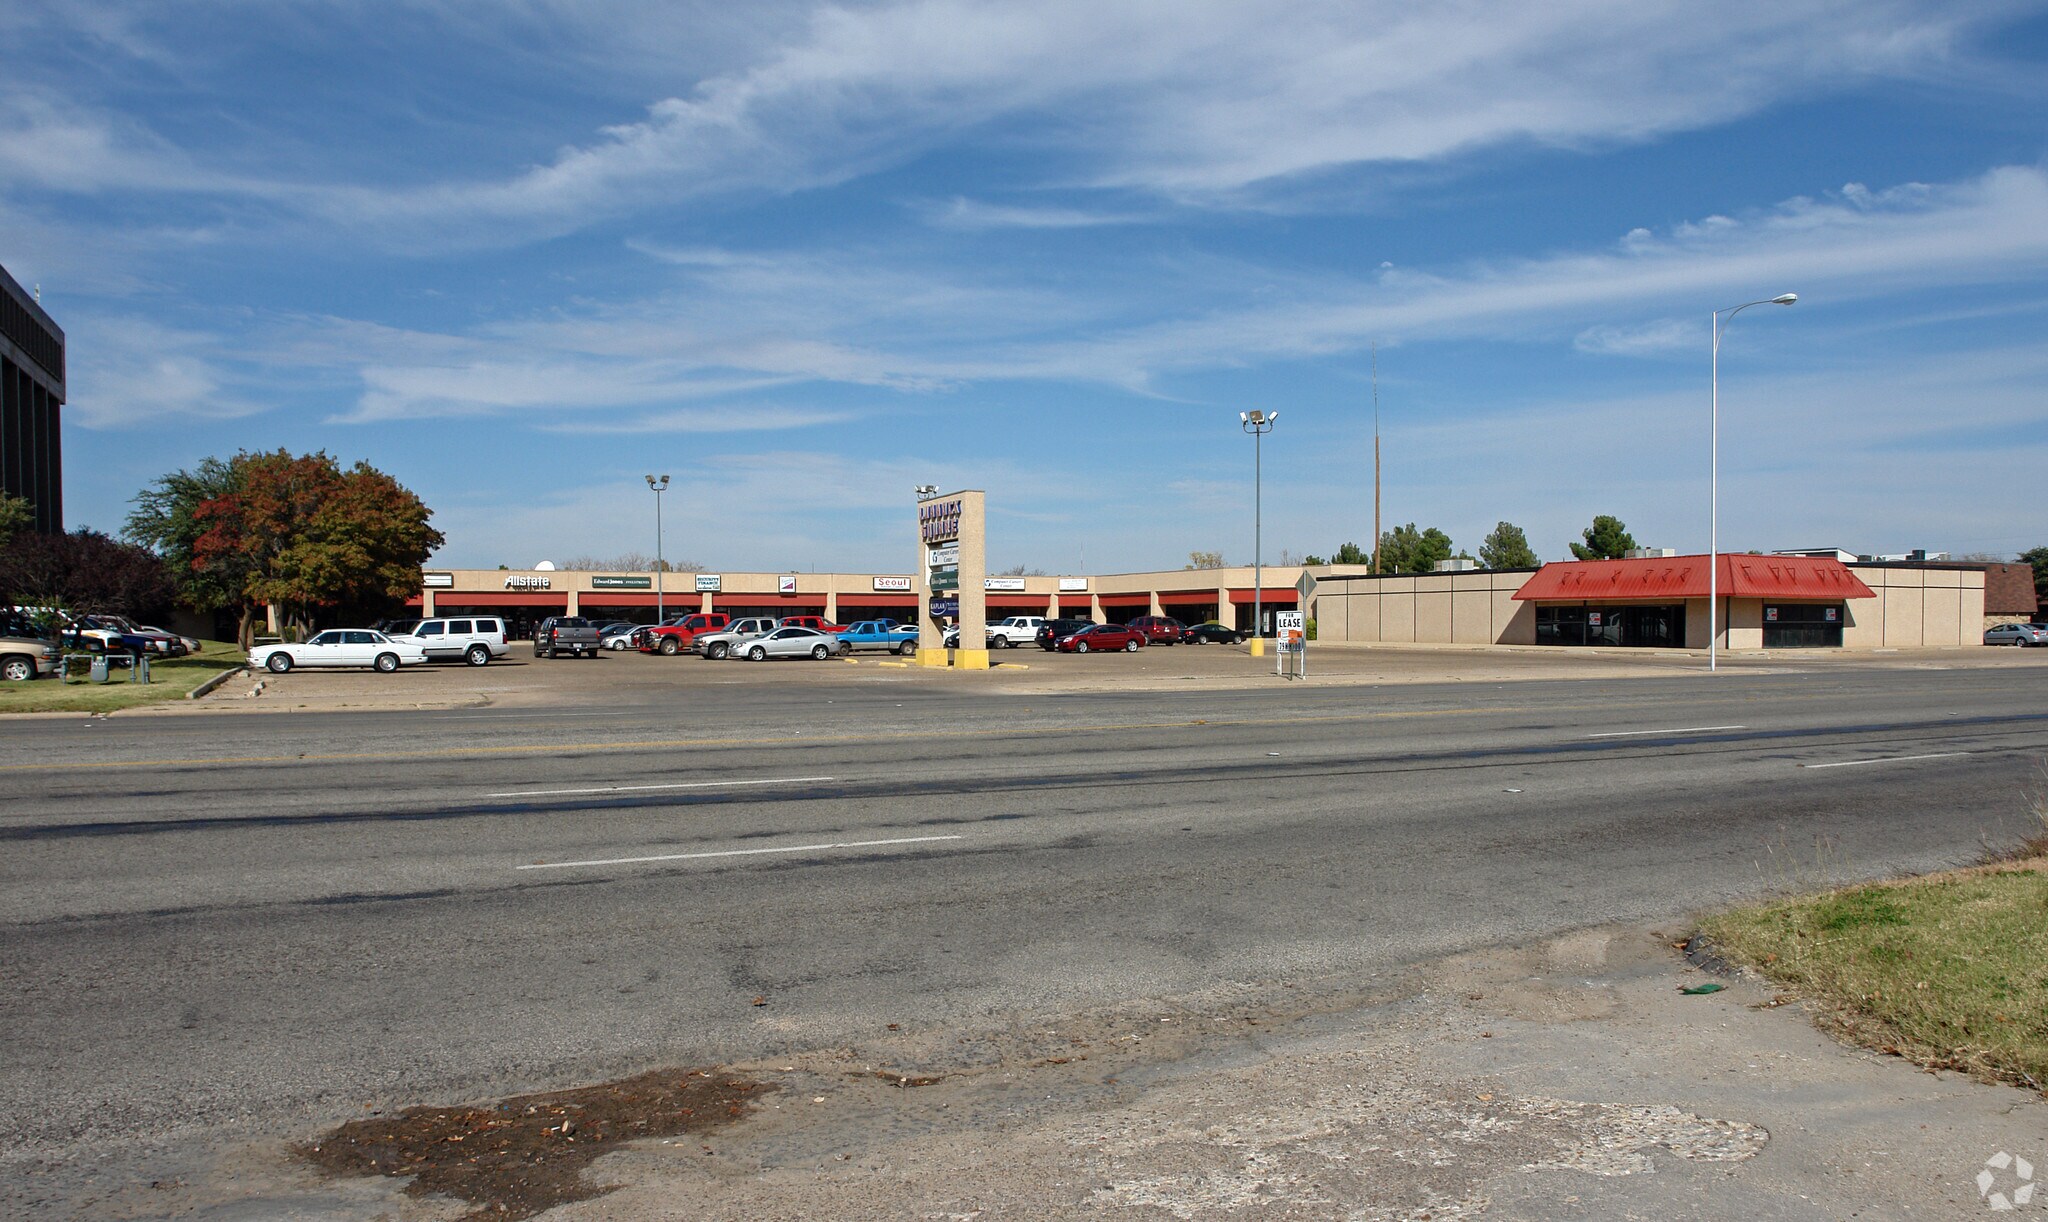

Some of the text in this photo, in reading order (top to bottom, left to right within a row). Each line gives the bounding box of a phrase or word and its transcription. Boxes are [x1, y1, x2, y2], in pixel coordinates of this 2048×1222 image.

[504, 575, 550, 588] Allstate
[878, 578, 906, 586] Seoul
[1279, 618, 1301, 628] LEASE
